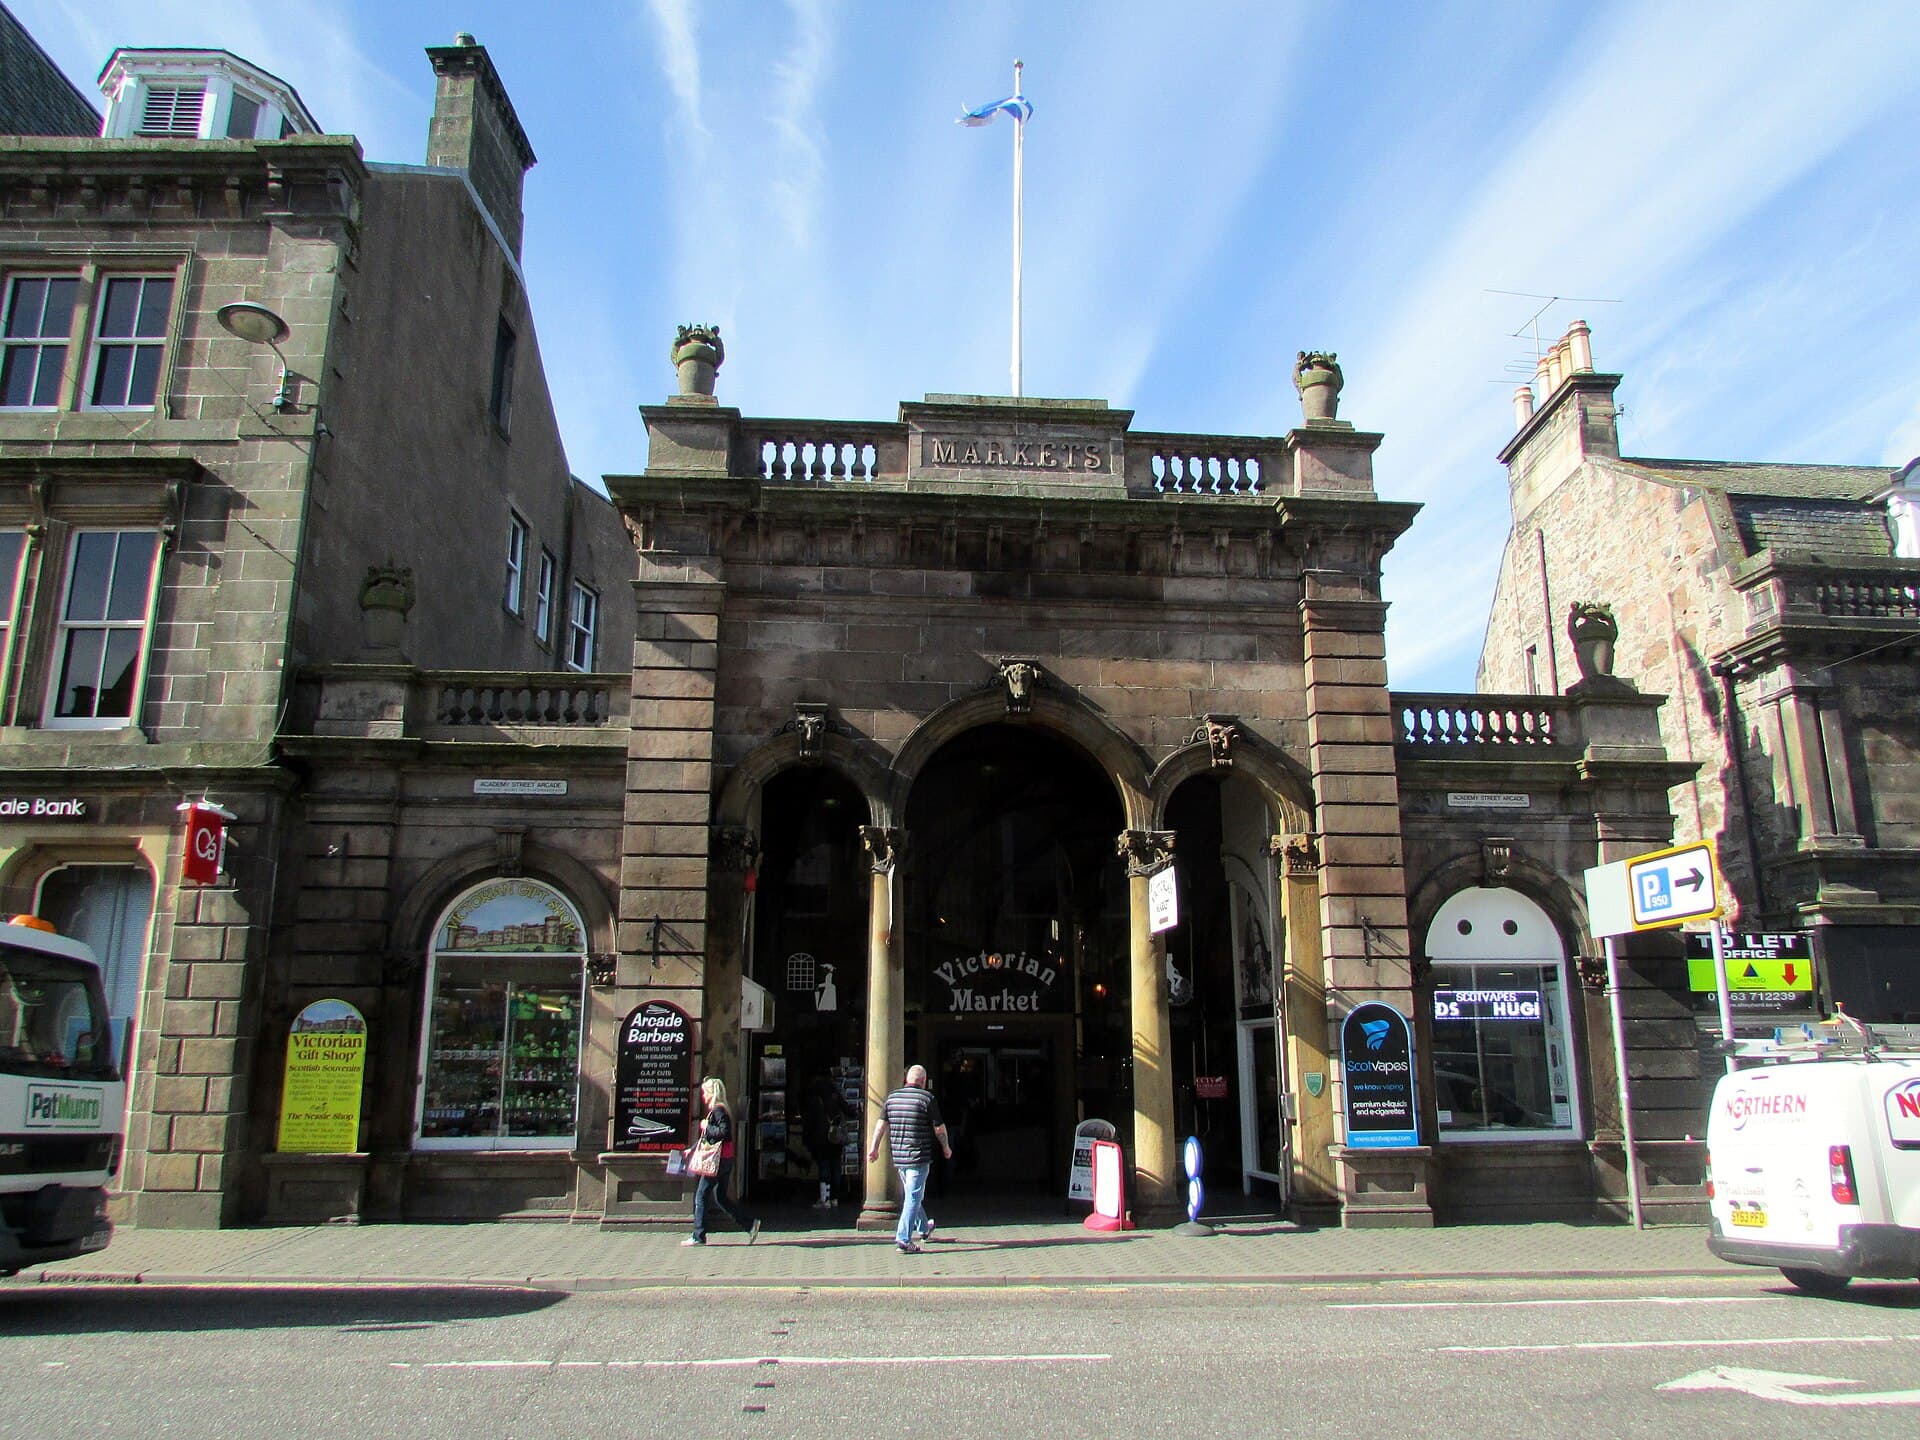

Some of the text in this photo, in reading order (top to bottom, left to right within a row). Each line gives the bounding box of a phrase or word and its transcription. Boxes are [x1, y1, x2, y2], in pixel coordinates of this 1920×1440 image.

[931, 437, 1103, 469] MARKETS
[35, 798, 84, 814] Bank
[1642, 874, 1668, 909] P 950
[446, 884, 577, 931] VICTORIAN GIFT SHOP
[1745, 934, 1797, 948] LET
[1723, 950, 1777, 958] OFFICE
[932, 949, 1056, 986] Victorian
[949, 987, 1040, 1012] Market
[1456, 992, 1517, 1002] SCOTVAPES
[1707, 992, 1796, 1001] 063 712239
[630, 1012, 683, 1028] Arcade
[293, 1034, 362, 1048] Victorian
[627, 1027, 685, 1043] Barbers
[288, 1064, 361, 1072] Scottish Souvenirs
[1352, 1100, 1381, 1109] premium
[1725, 1094, 1807, 1119] NORTHERN
[1894, 1092, 1920, 1118] N
[288, 1112, 303, 1120] The
[333, 1112, 354, 1122] Shop
